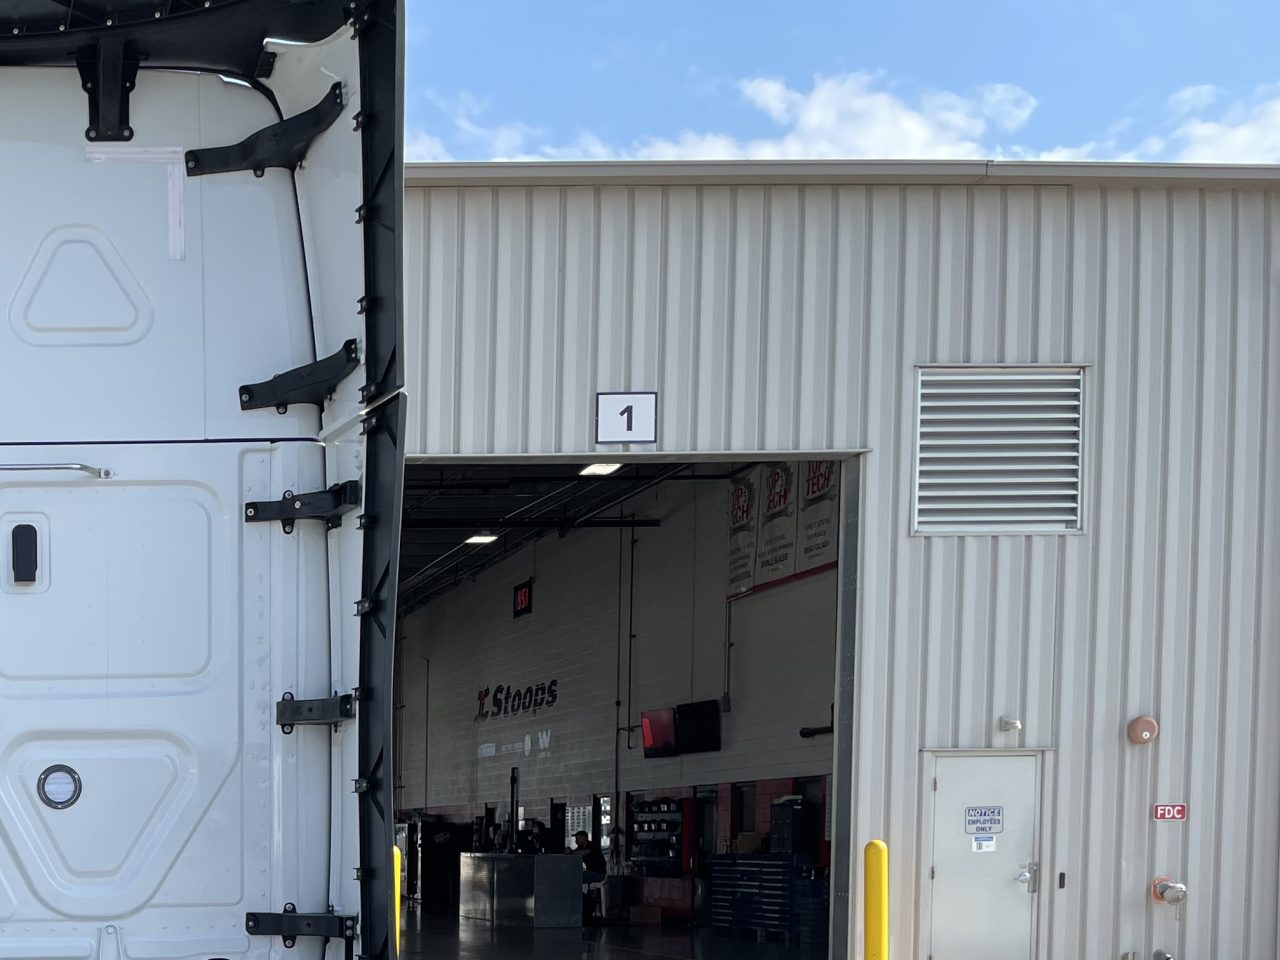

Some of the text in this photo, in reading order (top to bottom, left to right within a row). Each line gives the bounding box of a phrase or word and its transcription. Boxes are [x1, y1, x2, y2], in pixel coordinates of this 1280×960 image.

[619, 405, 633, 432] 1
[806, 470, 832, 497] TECH
[491, 679, 558, 718] Stoops
[967, 808, 1001, 817] NOTICE
[1157, 806, 1182, 818] FDC
